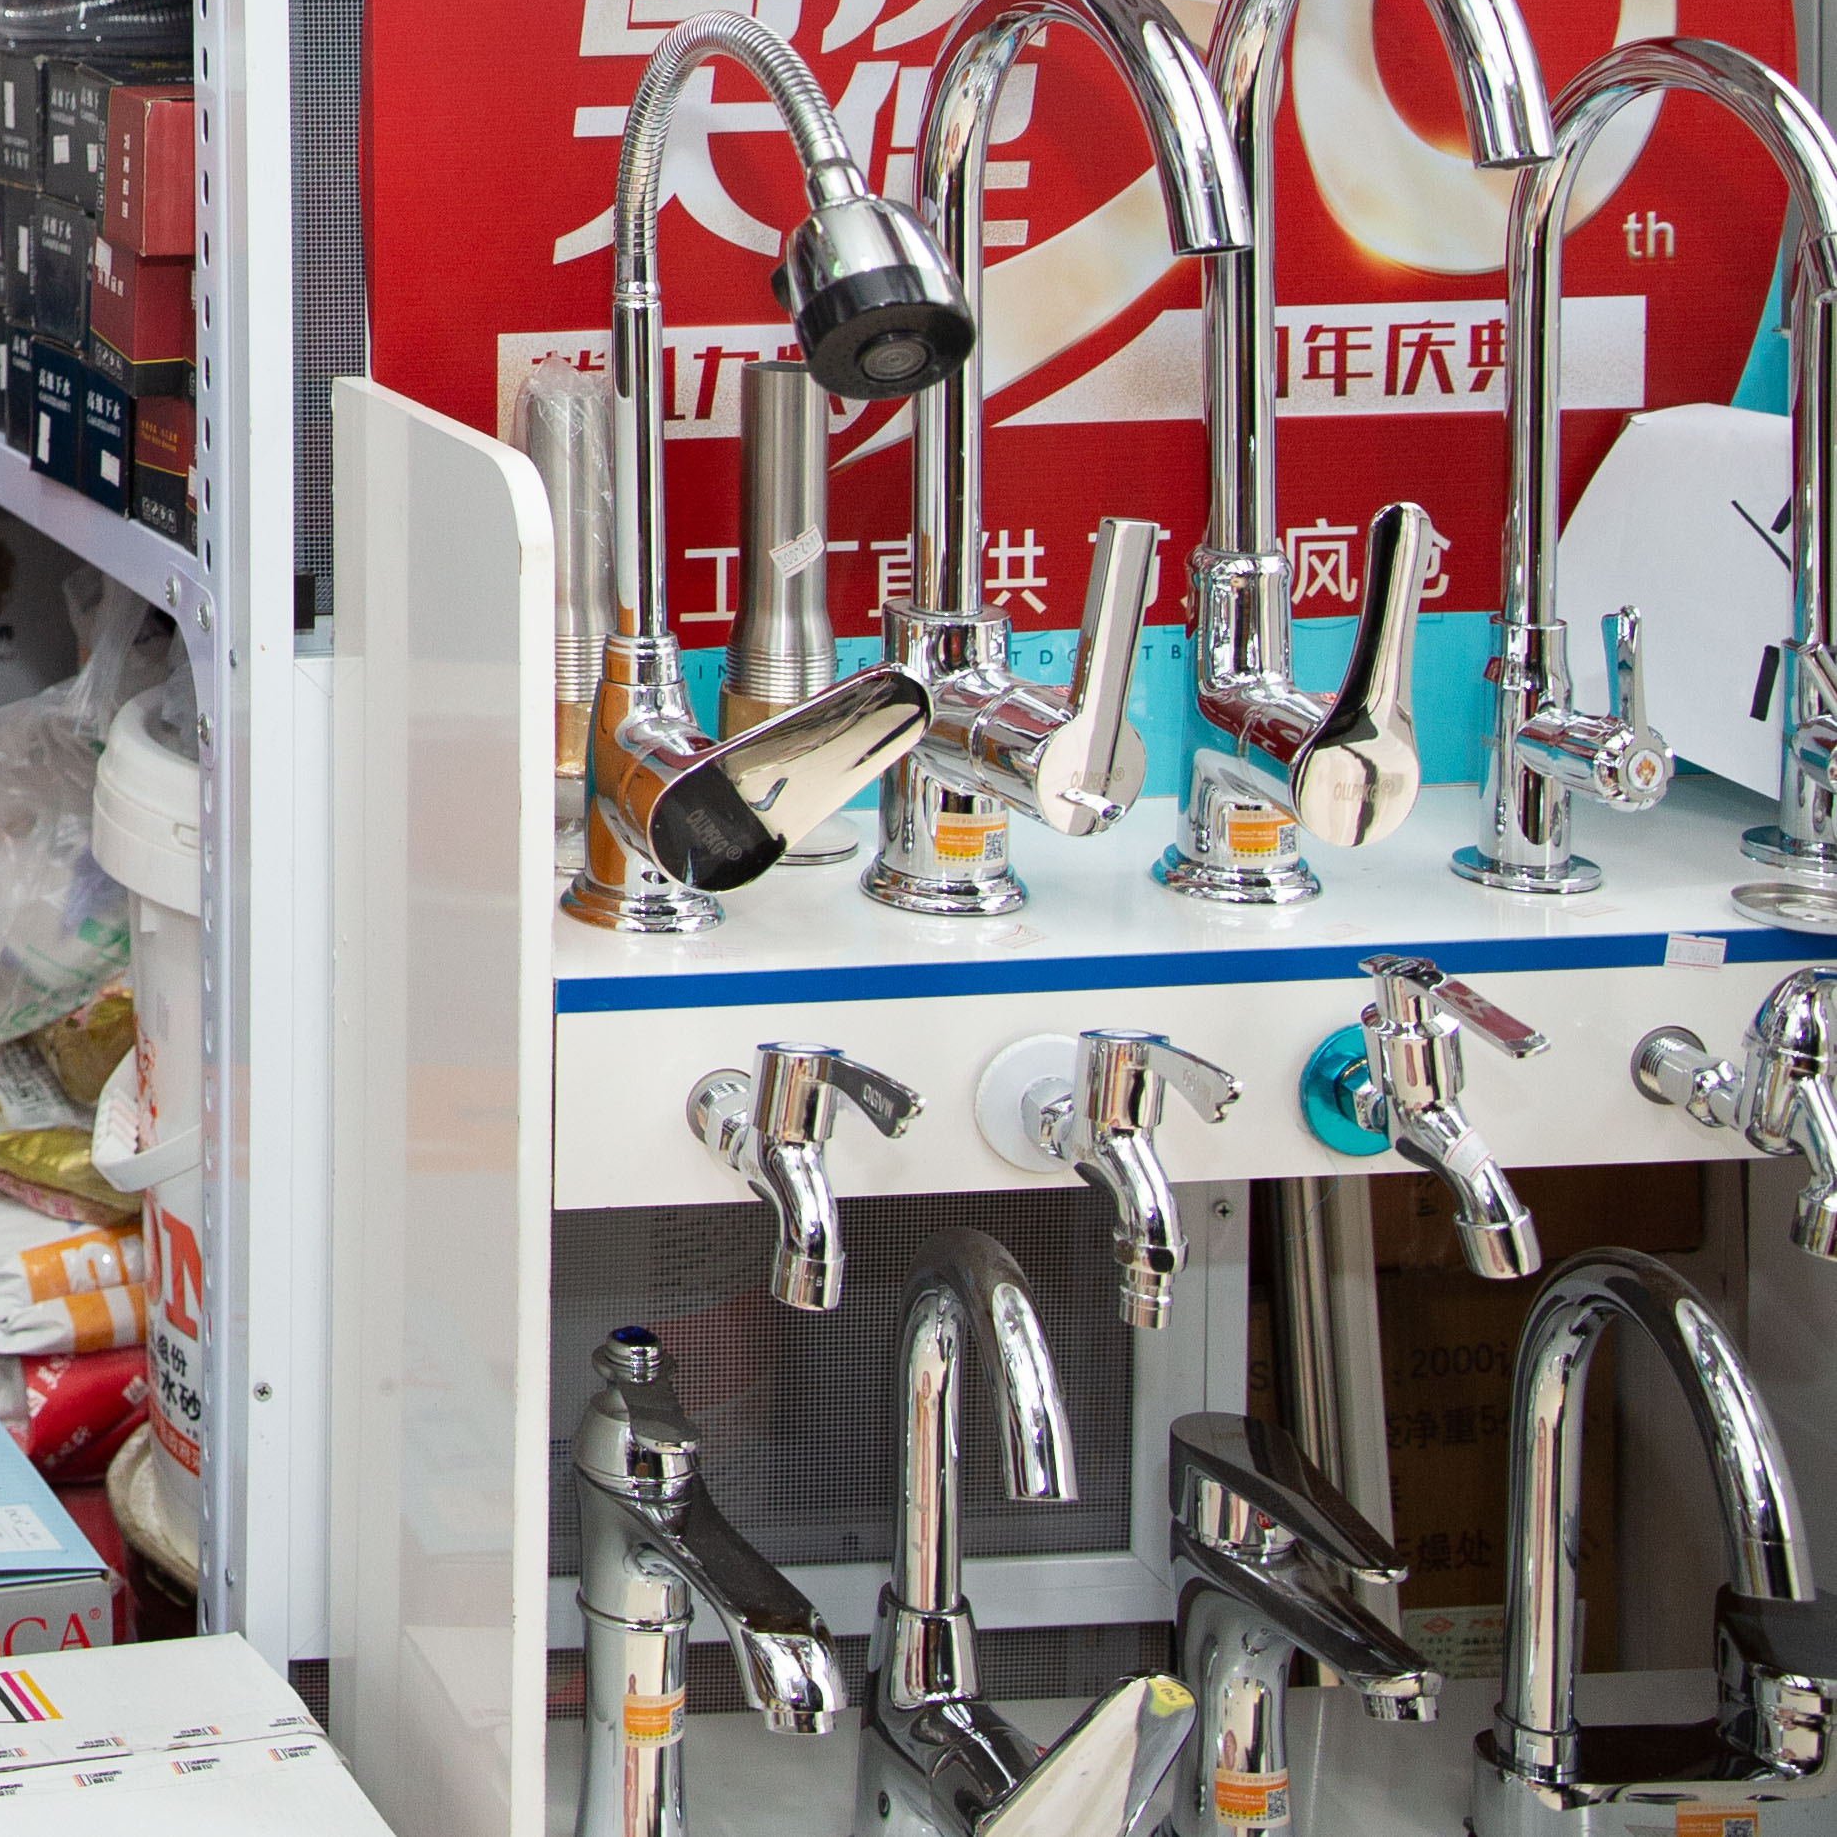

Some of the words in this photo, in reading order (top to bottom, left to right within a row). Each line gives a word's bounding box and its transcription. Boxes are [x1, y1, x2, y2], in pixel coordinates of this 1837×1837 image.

[1622, 213, 1676, 261] th
[1275, 319, 1507, 399] 年庆典
